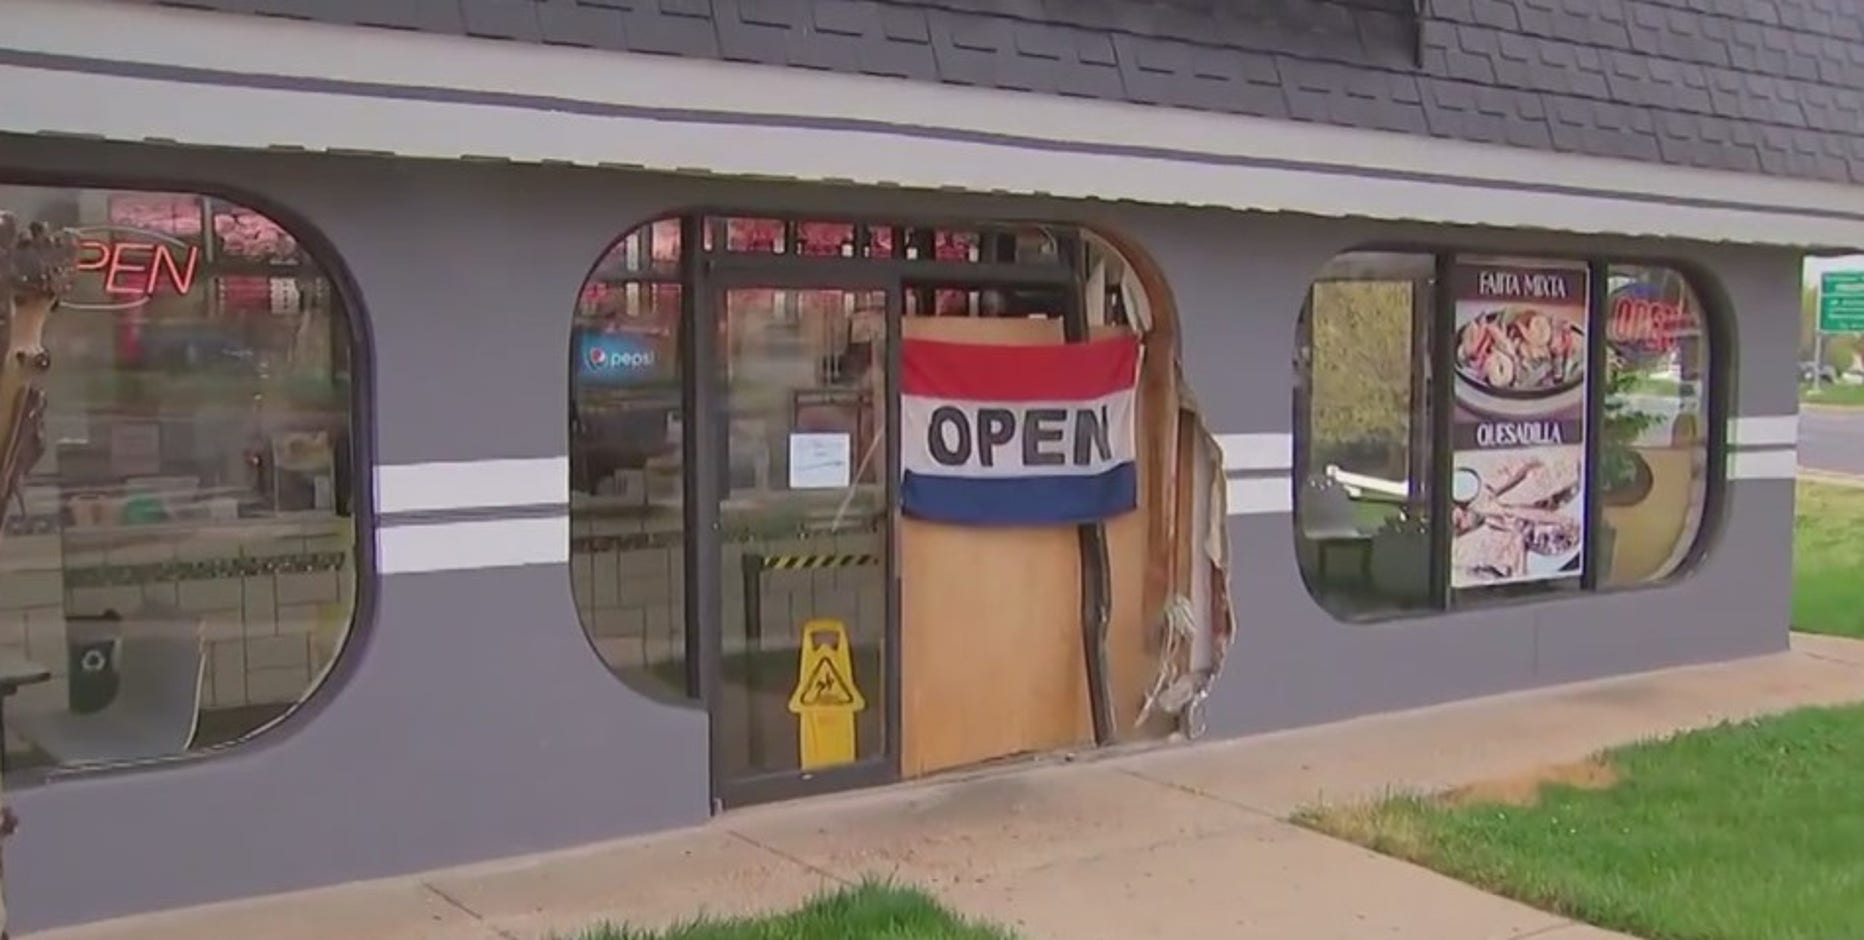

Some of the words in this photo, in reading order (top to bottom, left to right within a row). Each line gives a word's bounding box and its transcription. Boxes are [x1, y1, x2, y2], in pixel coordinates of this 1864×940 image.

[73, 241, 198, 294] PEN
[1523, 274, 1567, 298] MIXTA
[611, 350, 655, 370] pepsi
[928, 404, 1112, 466] OPEN
[1477, 421, 1562, 447] QUESADILLA
